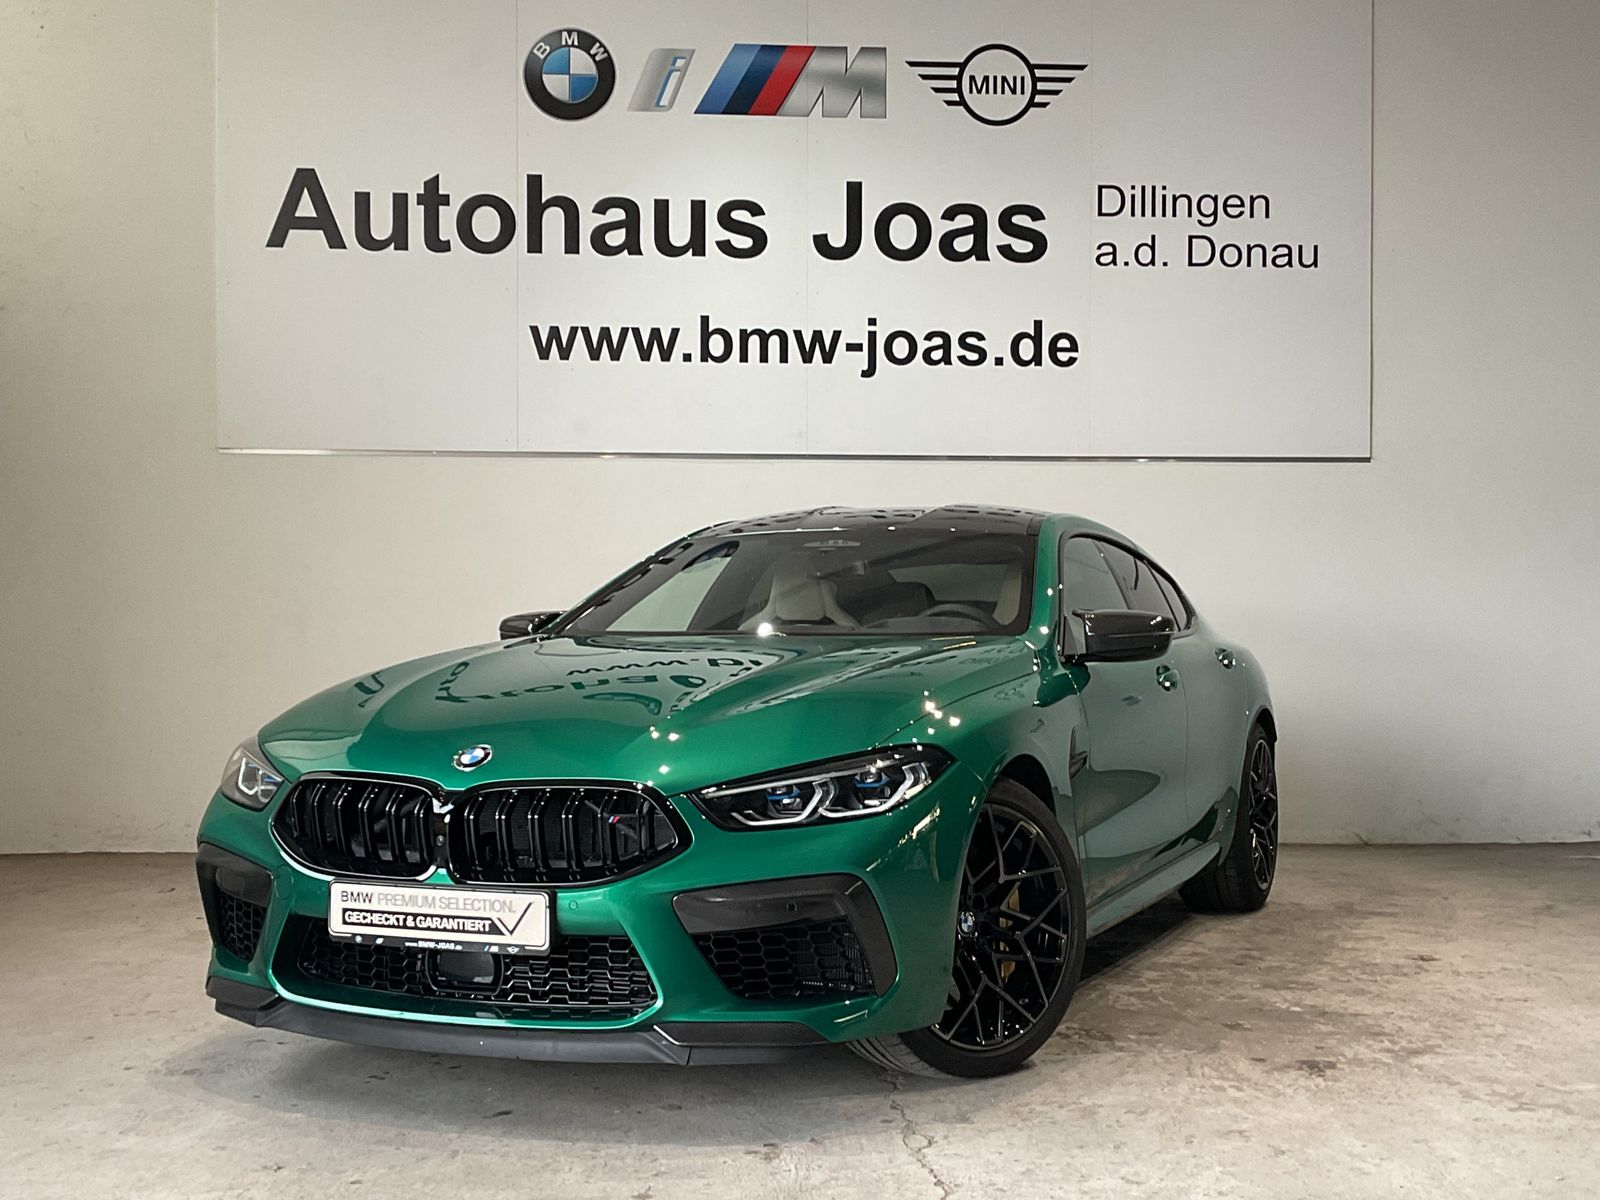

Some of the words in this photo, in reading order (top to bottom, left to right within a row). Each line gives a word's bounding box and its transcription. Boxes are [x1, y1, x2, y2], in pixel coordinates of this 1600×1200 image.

[532, 31, 609, 62] BMW
[968, 74, 1027, 96] MINI
[265, 167, 769, 259] Autohaus
[812, 180, 1049, 264] Joas
[1096, 183, 1271, 227] Dillingen
[1095, 235, 1170, 268] a.d.
[1187, 235, 1320, 269] Donau
[530, 315, 1080, 379] www.bmw-joas.de
[341, 890, 373, 904] BMW
[377, 893, 436, 909] PREMIUM
[344, 911, 405, 926] GECHECKT
[406, 915, 415, 927] &
[416, 916, 491, 932] GARANTIERT
